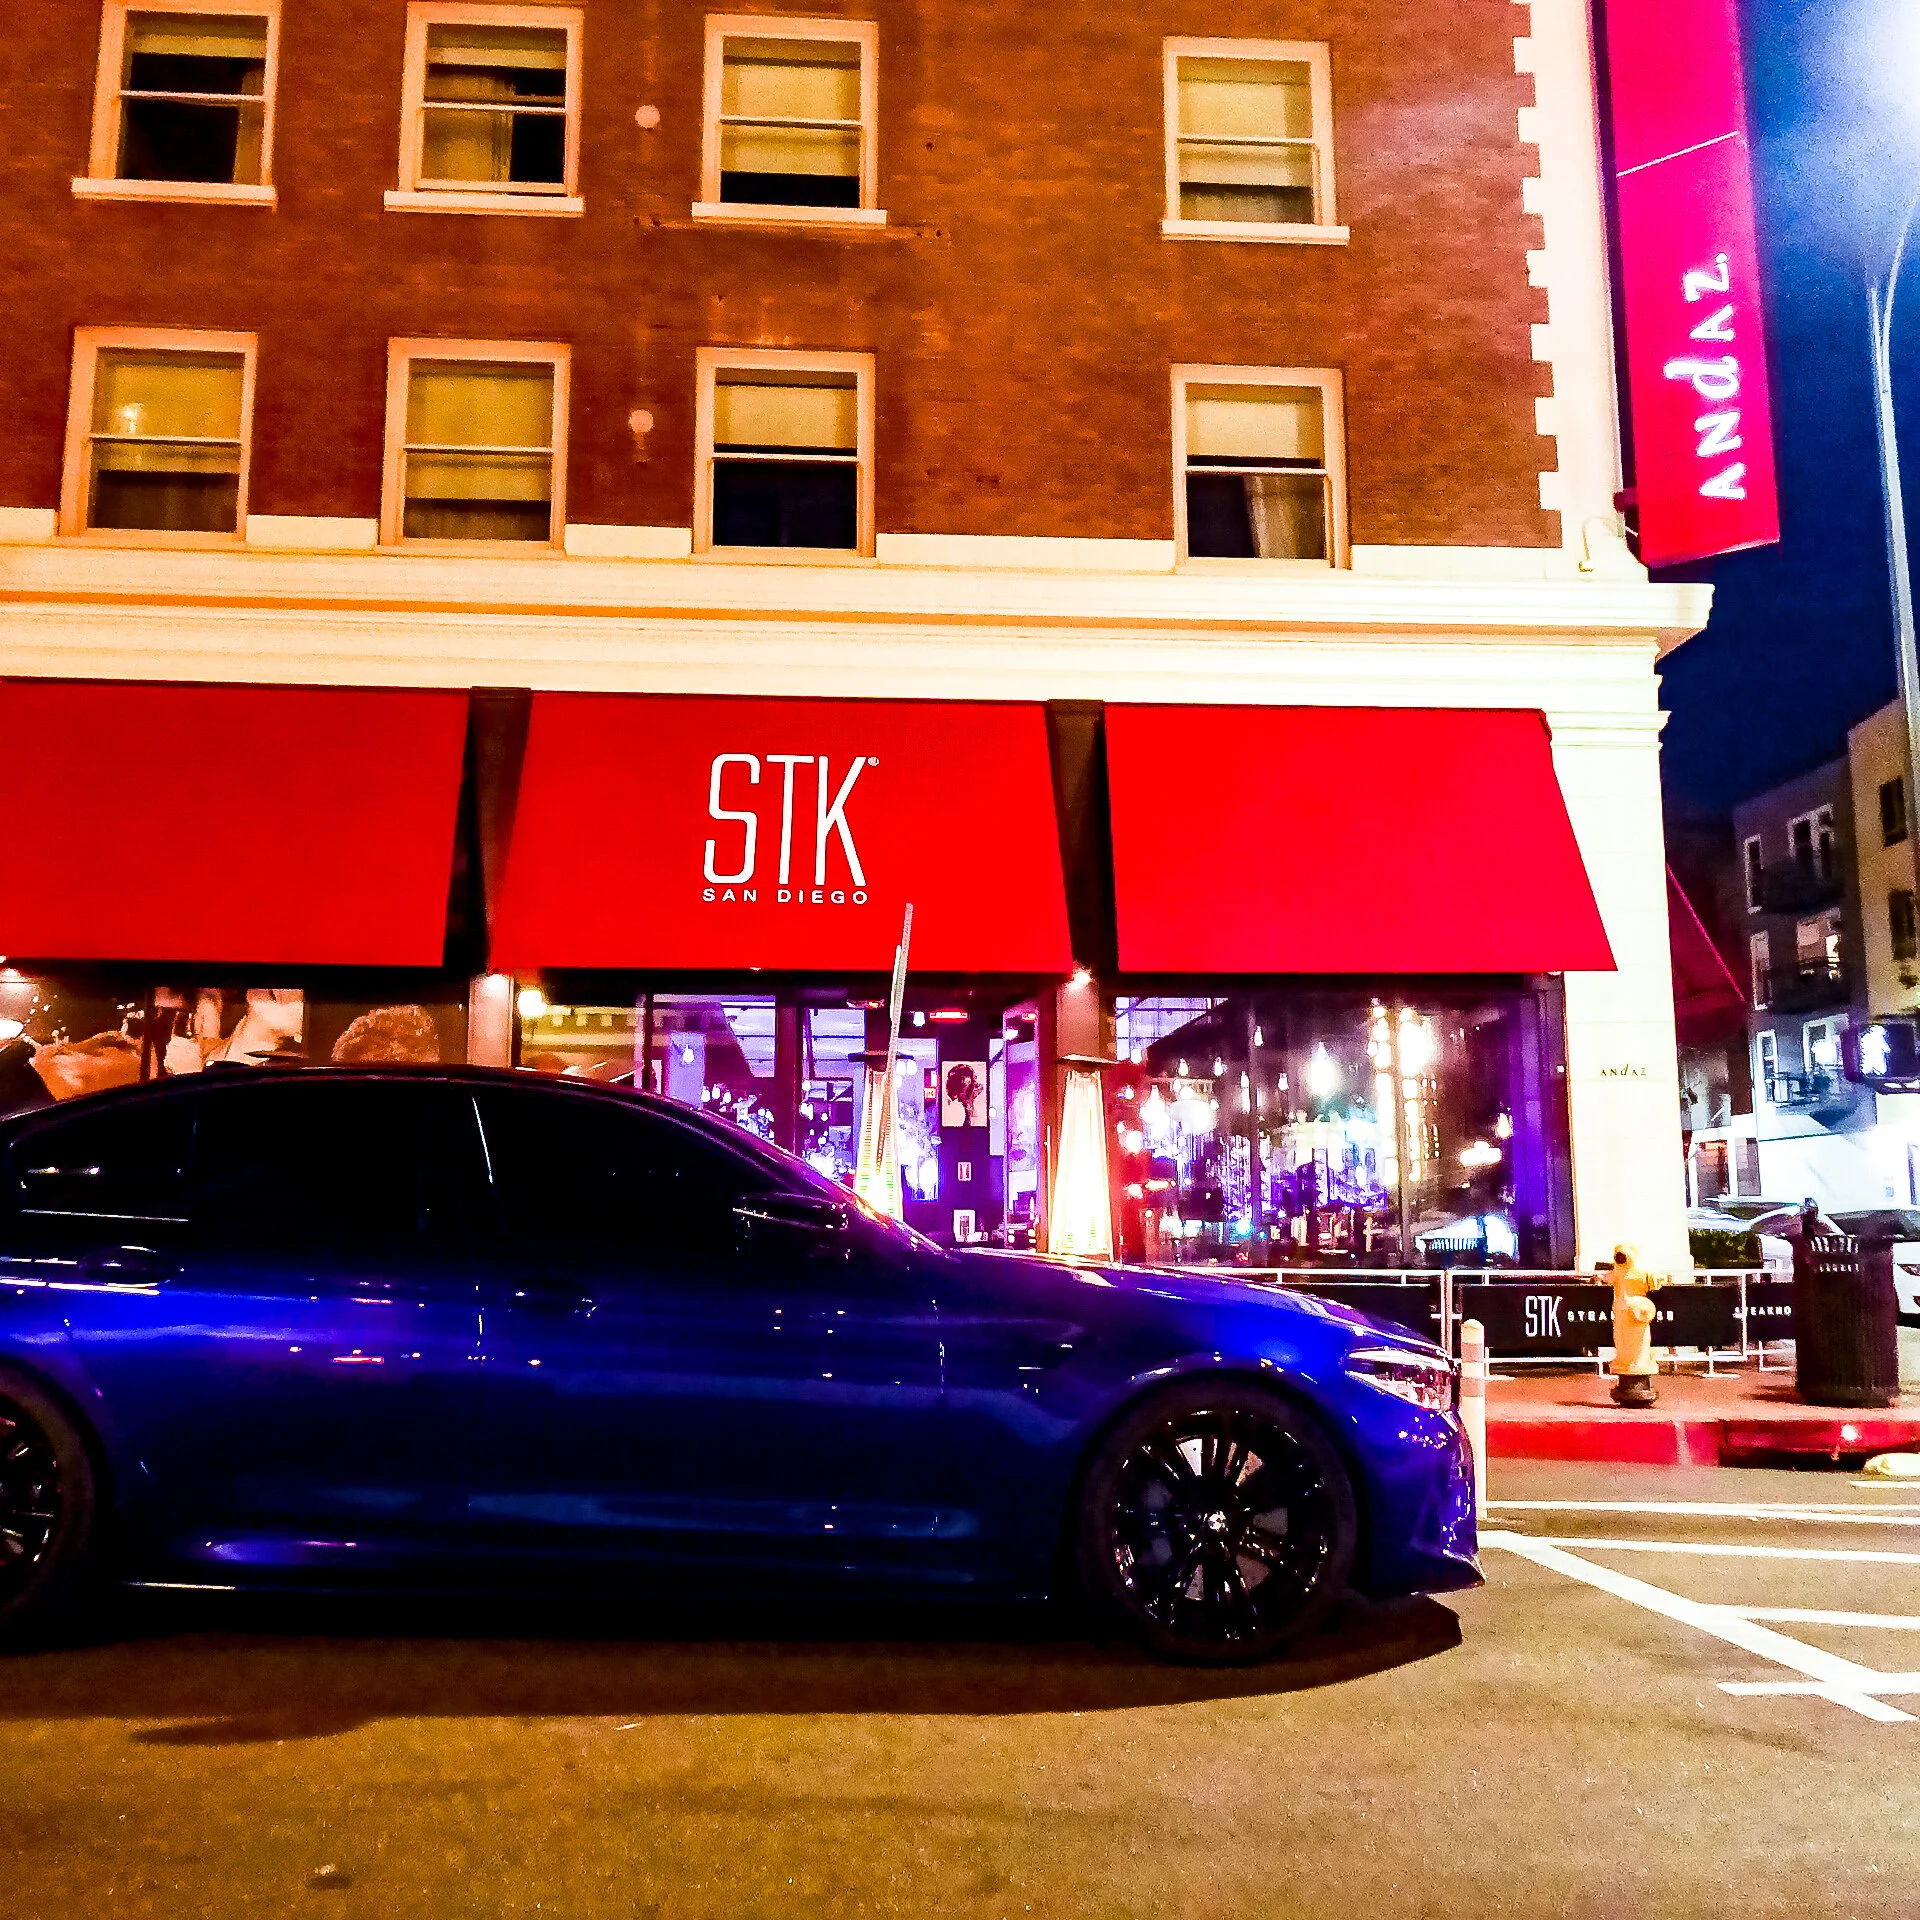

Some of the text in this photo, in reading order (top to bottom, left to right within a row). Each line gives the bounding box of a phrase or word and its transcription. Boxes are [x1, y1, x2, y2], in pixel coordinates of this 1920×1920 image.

[702, 888, 868, 905] SAN DIEGO
[1524, 1295, 1674, 1338] STK STEASE
